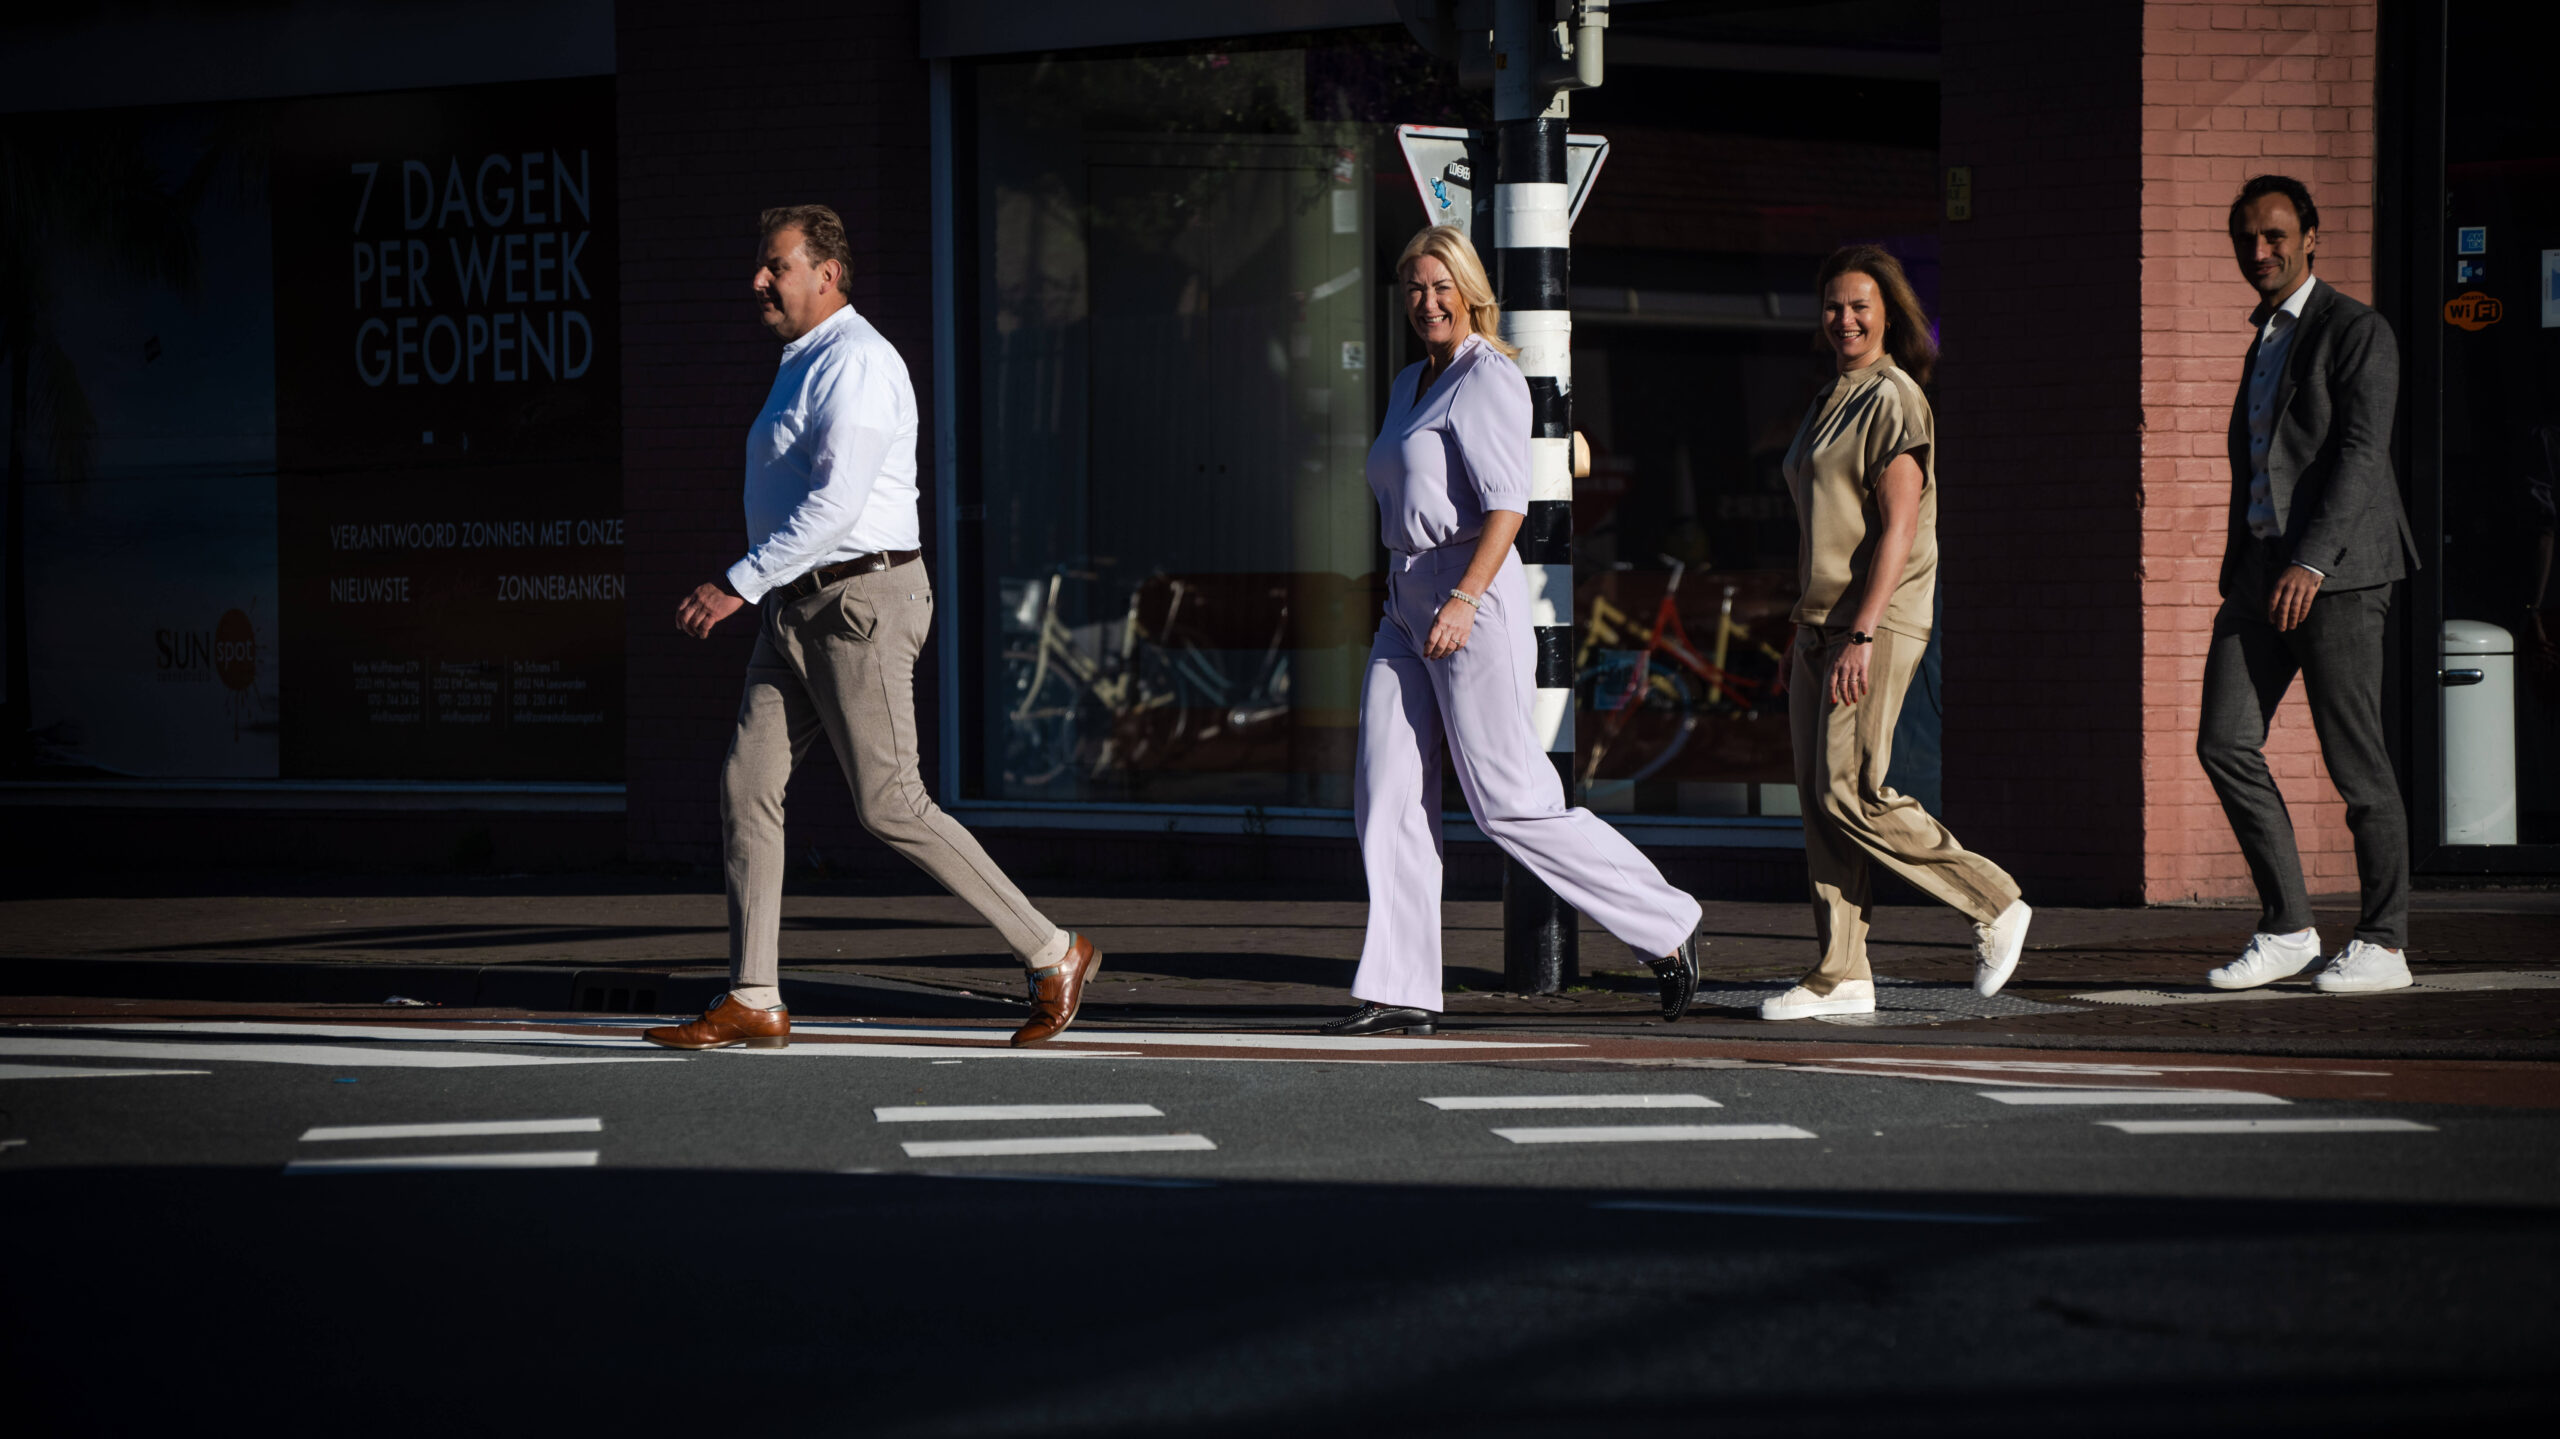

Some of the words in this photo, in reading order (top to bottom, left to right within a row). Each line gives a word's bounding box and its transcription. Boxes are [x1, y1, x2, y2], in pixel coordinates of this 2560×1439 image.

[351, 161, 380, 236] 7
[402, 146, 591, 231] DAGEN
[353, 238, 433, 311] PER
[449, 229, 593, 308] WEEK
[354, 308, 594, 388] GEOPEND
[330, 522, 457, 549] VERANTWOORD
[461, 520, 535, 548] ZONNEN
[539, 519, 572, 547] MET
[576, 518, 625, 546] ONZE
[329, 576, 410, 603] NIEUWSTE
[496, 573, 626, 601] ZONNEBANKEN
[156, 629, 210, 669] SUN
[216, 641, 254, 671] spot
